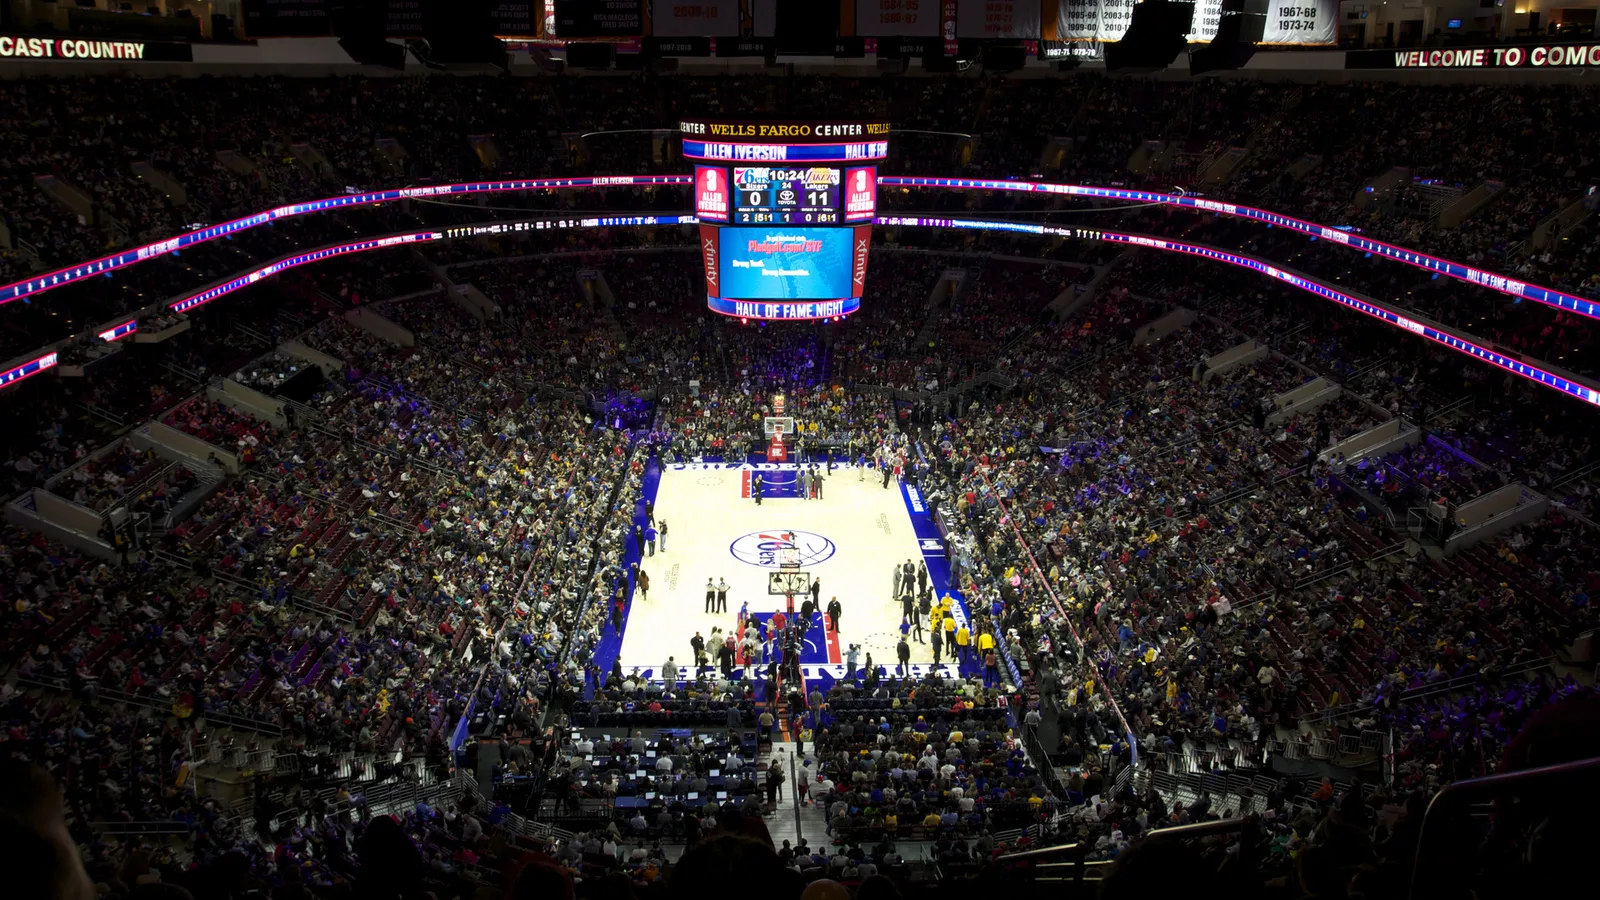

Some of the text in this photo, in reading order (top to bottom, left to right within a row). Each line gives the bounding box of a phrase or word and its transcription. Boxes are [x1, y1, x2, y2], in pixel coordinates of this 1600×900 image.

[1279, 7, 1316, 18] 1967-68
[1279, 20, 1315, 31] 1973-74
[0, 37, 144, 59] CAST COUNTRY
[1395, 50, 1484, 67] WELCOME
[1494, 48, 1521, 66] TO
[681, 122, 705, 134] CENTER
[711, 124, 862, 136] WELLS FARGO CENTER
[704, 143, 787, 160] ALLEN IVERSON
[846, 143, 866, 159] HALL
[769, 170, 804, 181] 10:24
[750, 191, 761, 206] 0
[808, 192, 828, 206] 11
[743, 214, 750, 222] 2
[704, 239, 717, 286] xfinity
[854, 239, 866, 286] xfinity
[1467, 269, 1526, 296] HALL OF FAME NIGHT
[736, 301, 844, 319] HALL OF FAME NIGHT
